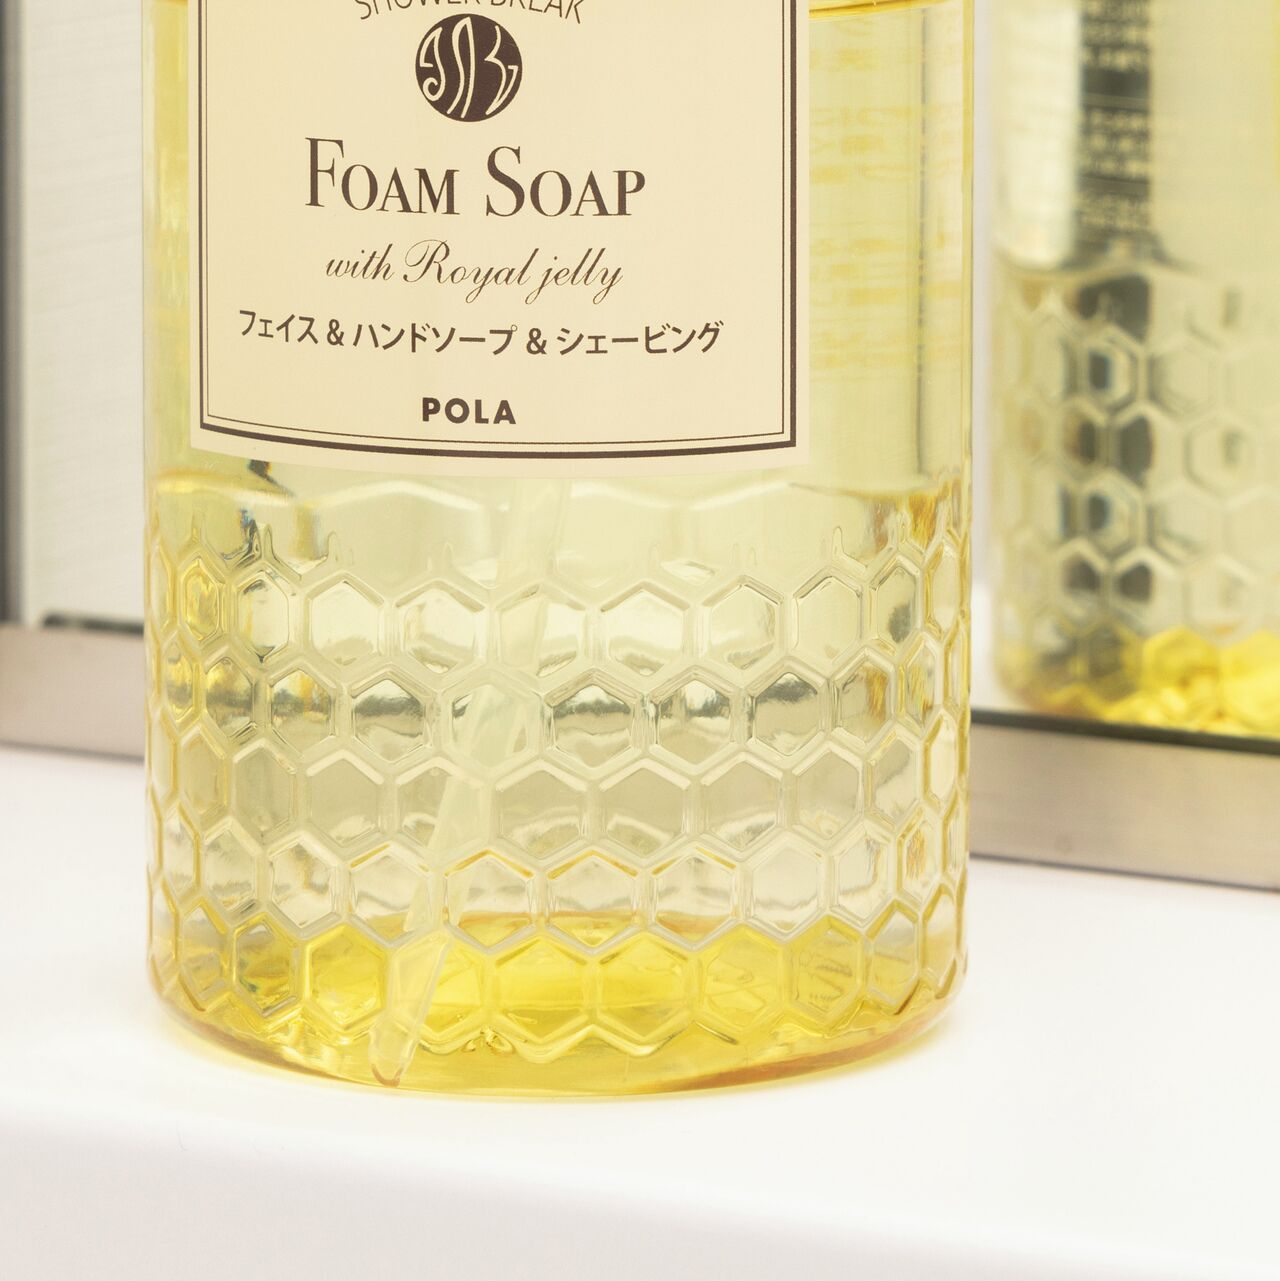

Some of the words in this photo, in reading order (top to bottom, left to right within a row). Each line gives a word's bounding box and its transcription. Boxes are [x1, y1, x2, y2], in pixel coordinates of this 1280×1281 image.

[324, 242, 395, 282] with
[402, 238, 532, 305] Royal
[524, 246, 624, 306] jelly
[421, 395, 518, 426] POLA
